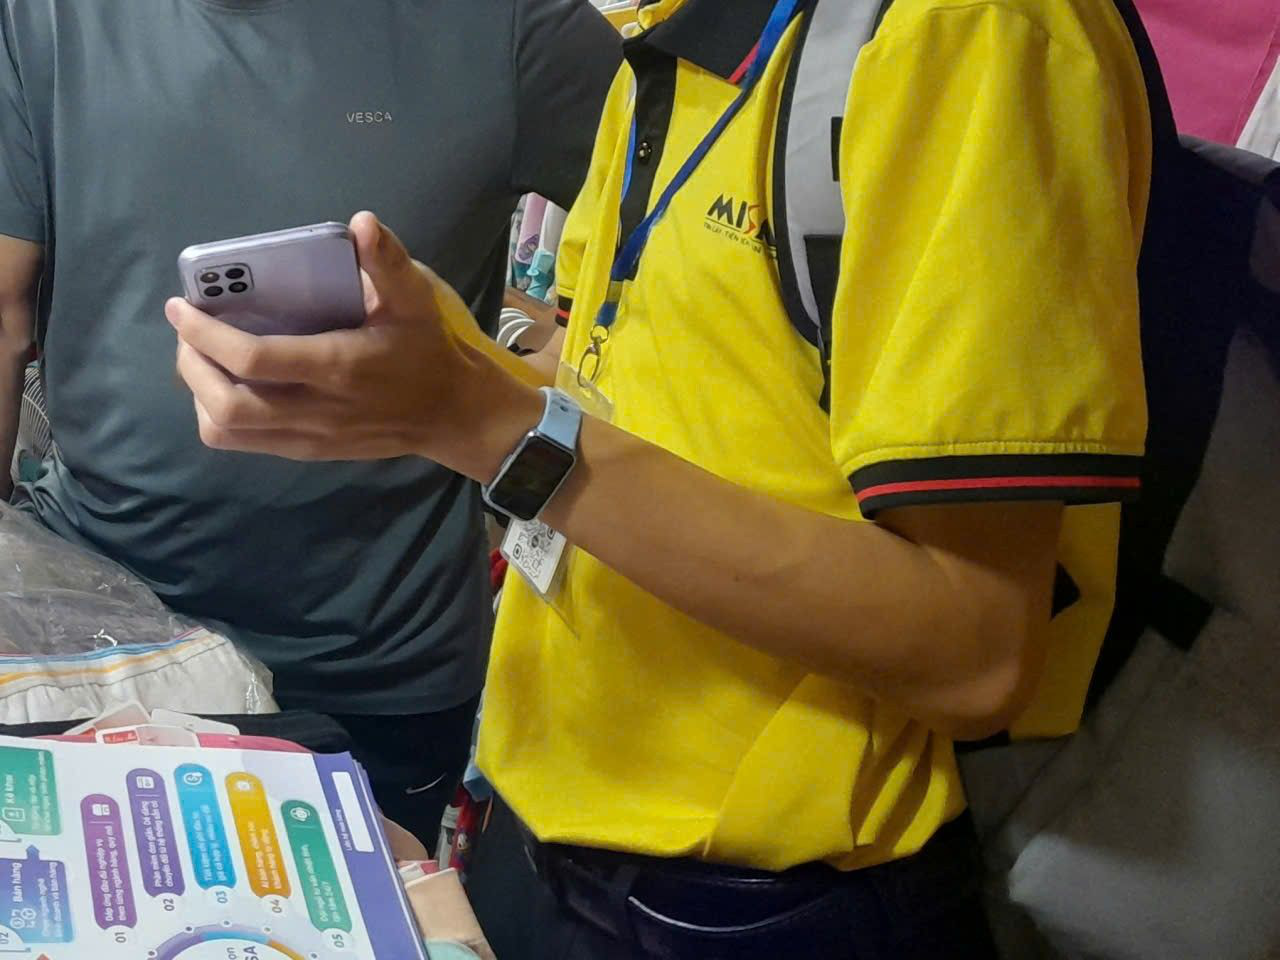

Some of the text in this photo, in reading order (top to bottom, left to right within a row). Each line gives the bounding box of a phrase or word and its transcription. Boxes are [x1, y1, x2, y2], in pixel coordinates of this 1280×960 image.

[345, 110, 393, 125] VESCA
[216, 891, 228, 904] 03
[164, 898, 175, 911] 02
[271, 899, 282, 913] 04
[0, 932, 9, 945] 02
[115, 931, 127, 943] 01
[331, 934, 344, 948] 05
